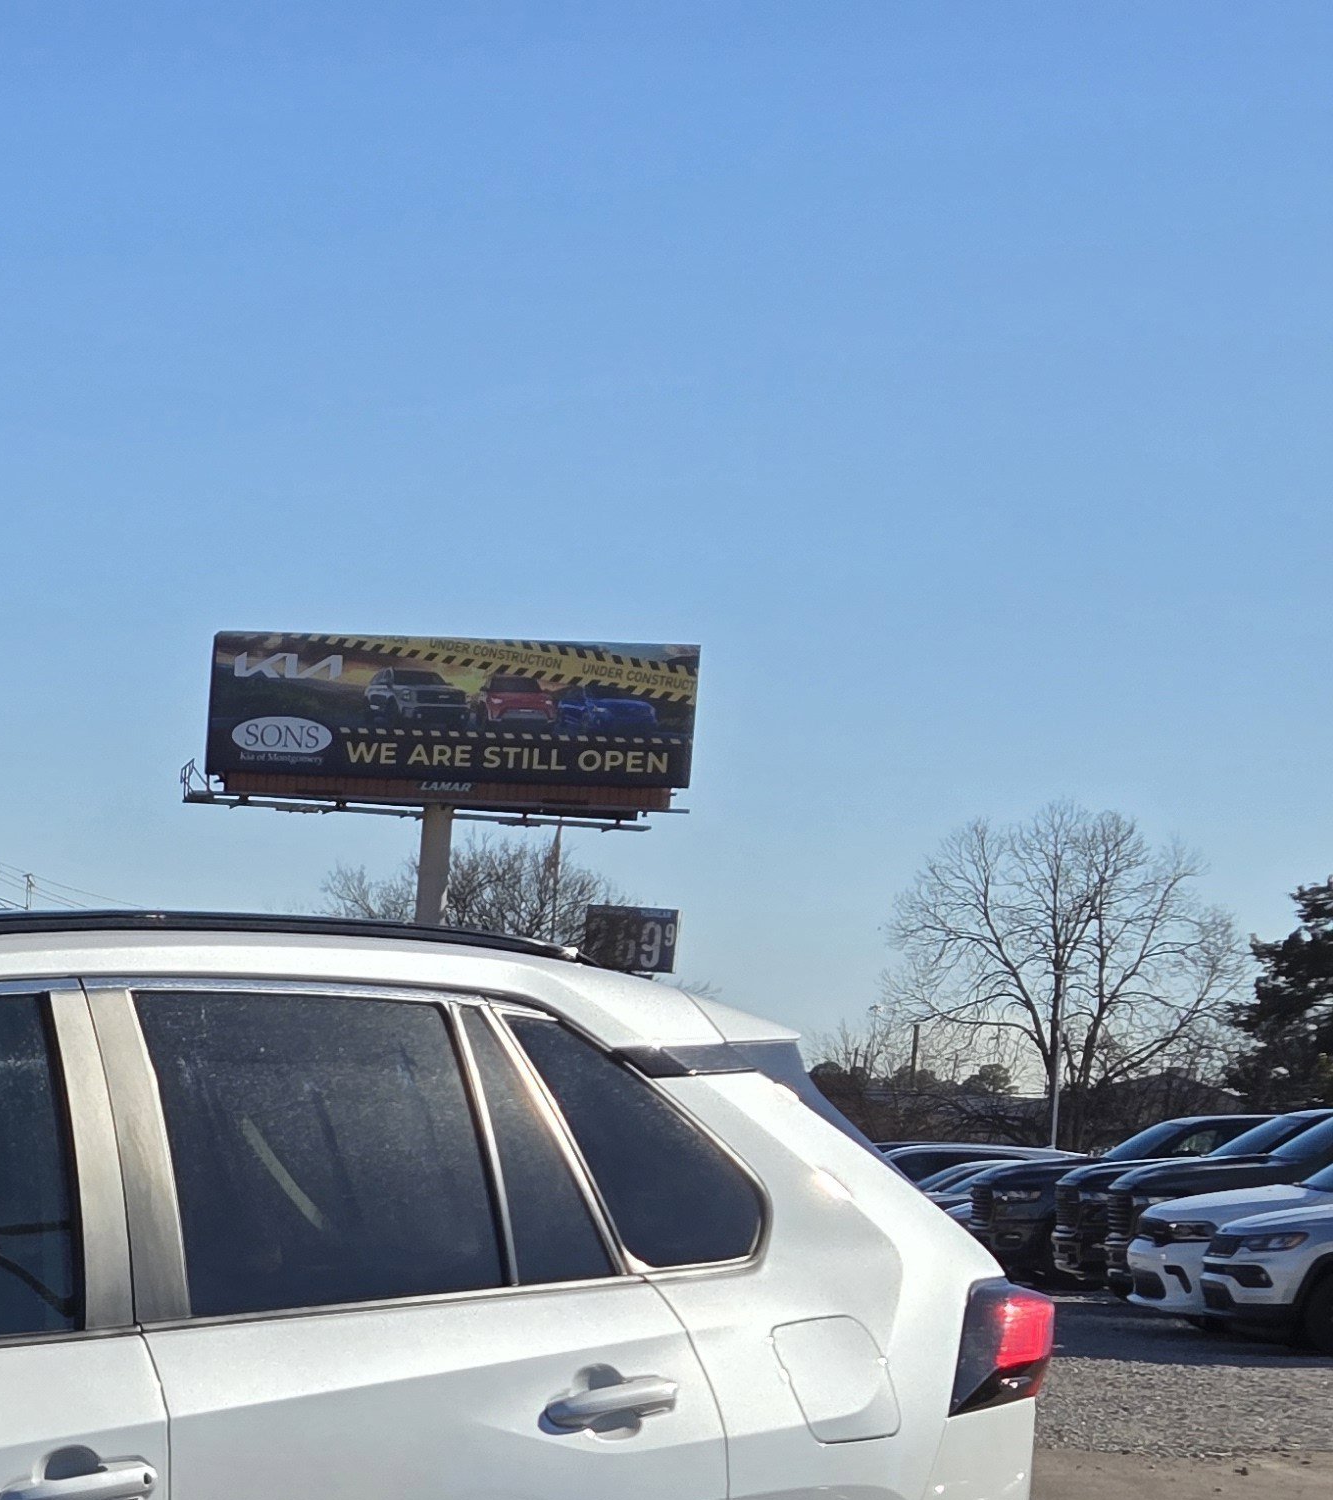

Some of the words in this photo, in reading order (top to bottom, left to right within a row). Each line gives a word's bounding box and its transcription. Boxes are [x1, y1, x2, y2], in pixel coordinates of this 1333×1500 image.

[234, 652, 343, 681] KIA
[430, 638, 470, 654] UNDER
[473, 643, 562, 669] CONSTRUCTION
[582, 662, 623, 681] UNDER
[244, 722, 320, 749] SONS
[239, 751, 255, 761] Kia
[267, 753, 324, 766] Montgomery
[346, 741, 398, 764] WE
[407, 744, 472, 767] ARE
[482, 746, 567, 771] STILL
[577, 750, 669, 773] OPEN
[419, 781, 472, 792] LAMAR
